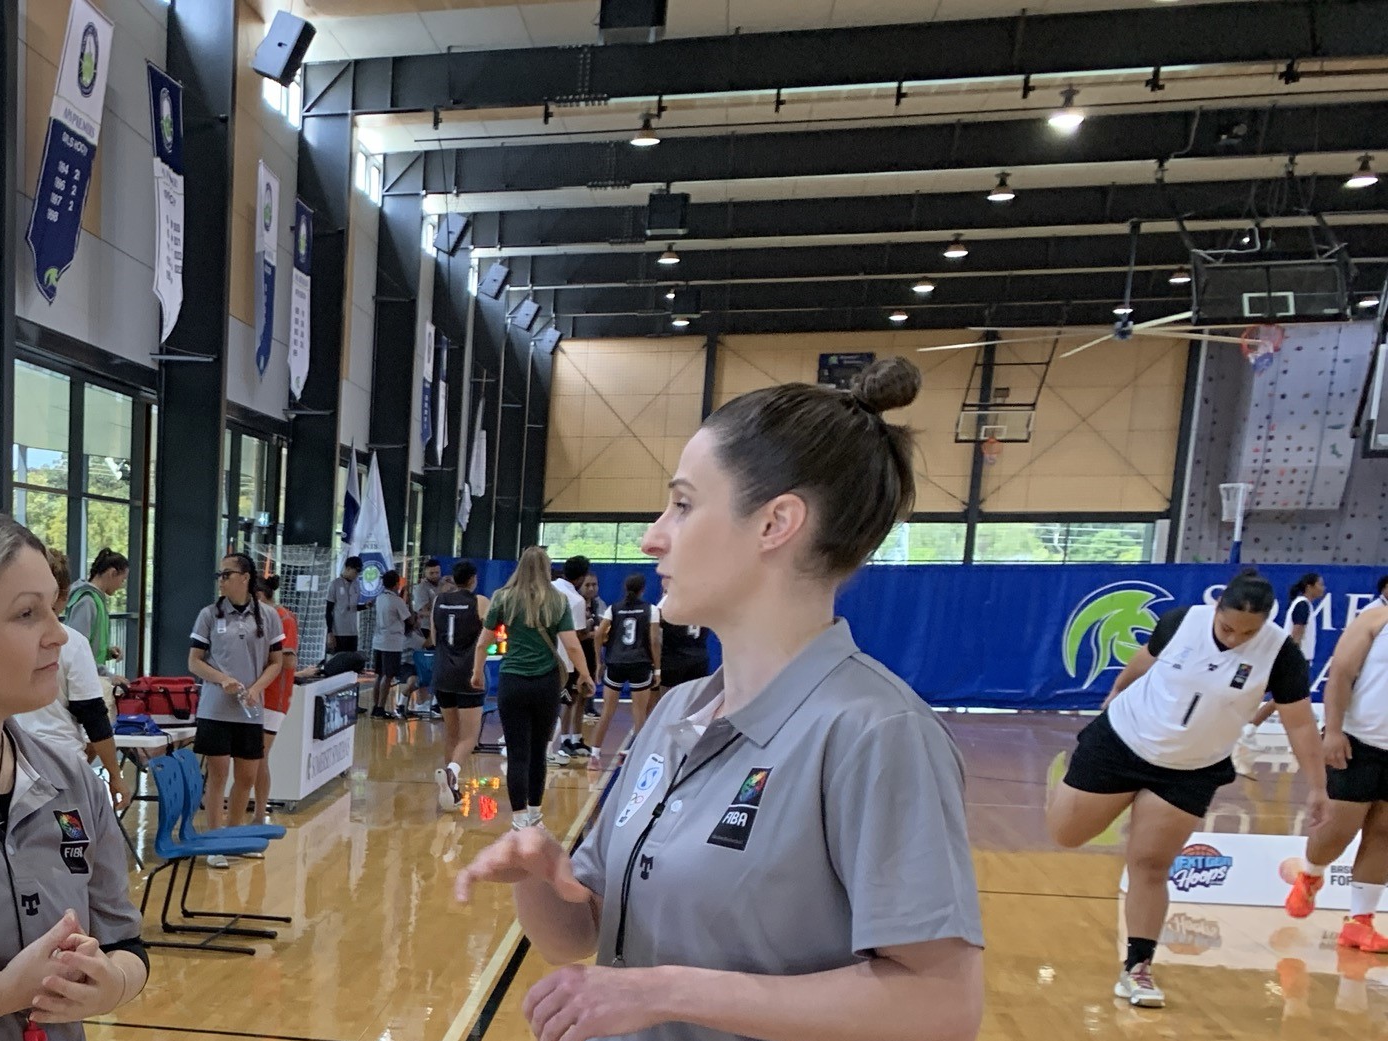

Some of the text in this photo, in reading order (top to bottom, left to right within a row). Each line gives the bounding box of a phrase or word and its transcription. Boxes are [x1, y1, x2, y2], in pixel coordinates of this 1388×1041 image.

[448, 614, 456, 645] 1
[622, 618, 638, 646] 3
[1181, 692, 1203, 727] 1
[1173, 865, 1228, 888] Hoops
